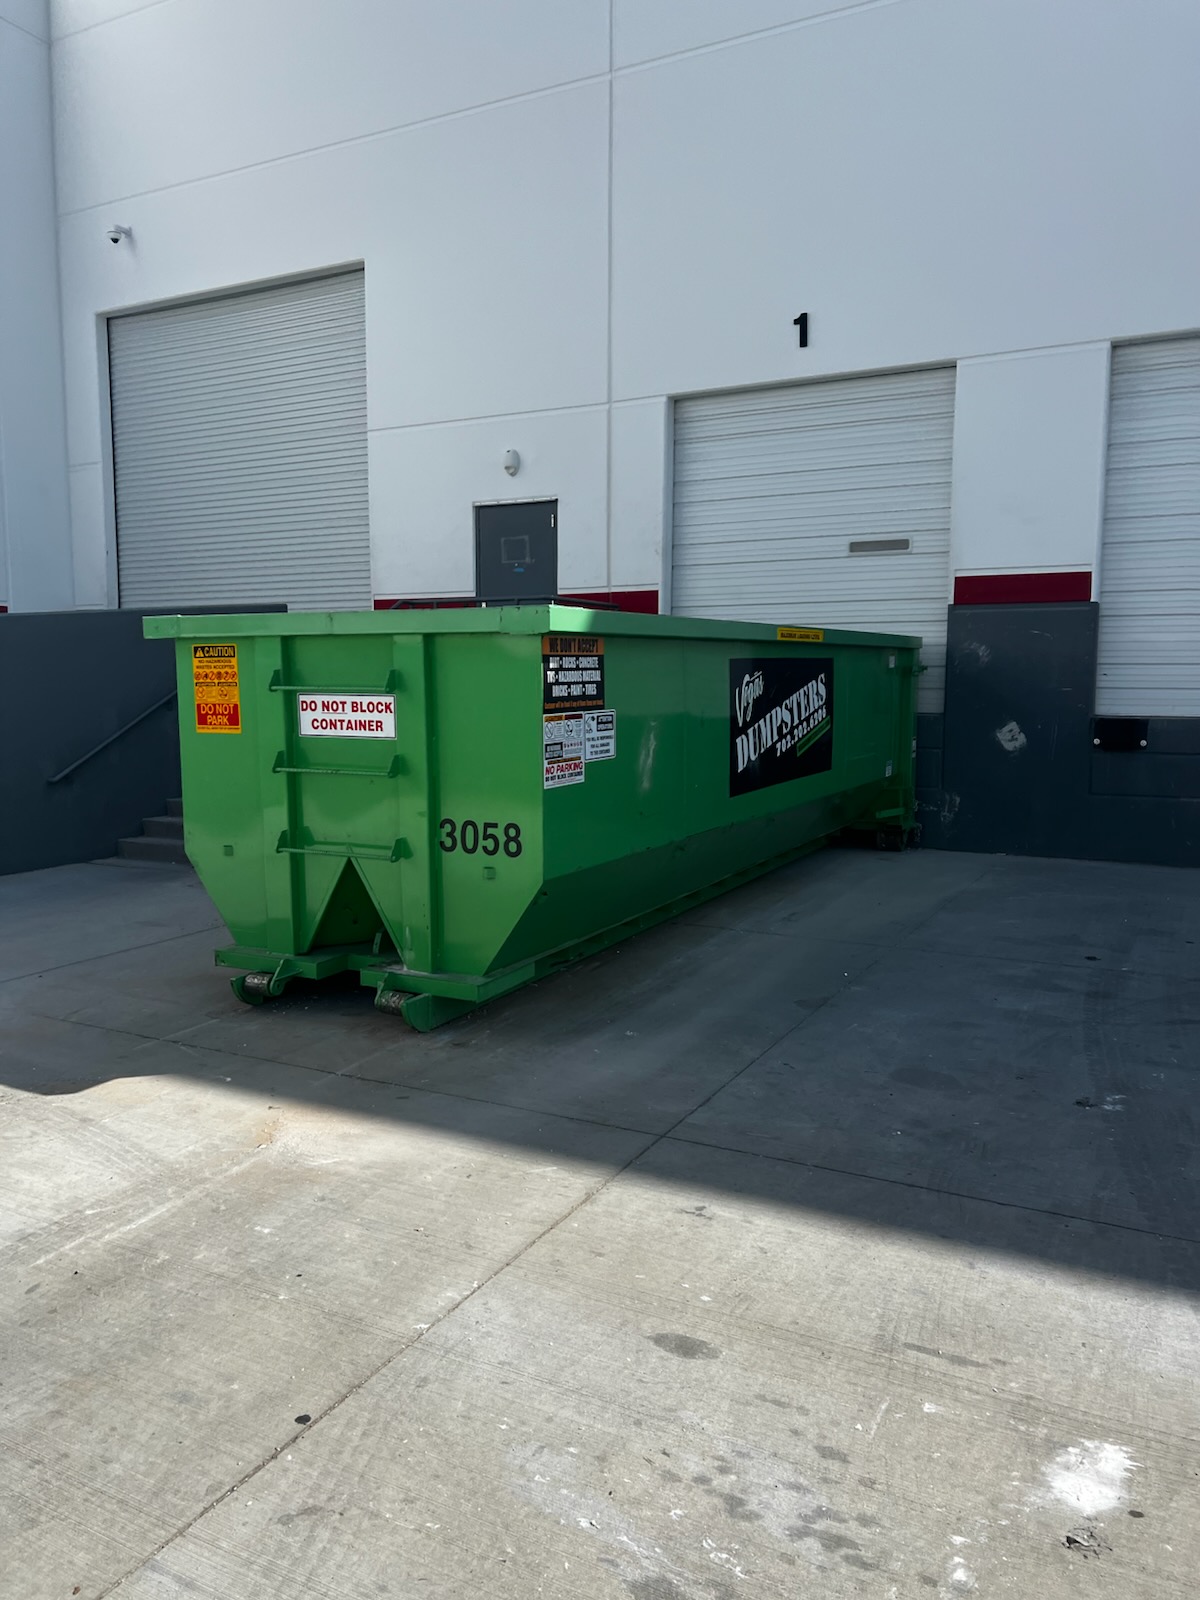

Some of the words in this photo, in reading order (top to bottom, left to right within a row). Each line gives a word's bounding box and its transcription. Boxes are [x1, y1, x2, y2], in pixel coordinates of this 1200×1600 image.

[794, 313, 808, 347] 1
[204, 646, 234, 656] CAUTION
[549, 638, 558, 653] WE
[560, 638, 576, 653] DON'T
[578, 638, 598, 653] ACCEPT
[562, 656, 576, 668] ROCKS
[579, 656, 598, 668] CONCRETE
[559, 670, 582, 682] HAZARDOUS
[583, 670, 601, 682] MATERIAL
[552, 685, 568, 697] BRICKS
[570, 684, 583, 696] PAINT
[585, 684, 597, 695] TIRES
[736, 671, 764, 727] Vegas
[200, 704, 214, 714] DO
[216, 704, 234, 714] NOT
[301, 700, 317, 712] DO
[322, 701, 347, 712] NOT
[351, 701, 393, 713] BLOCK
[207, 715, 229, 725] PARK
[312, 718, 383, 731] CONTAINER
[736, 673, 826, 773] DUMPSTERS
[545, 765, 554, 775] NO
[556, 761, 584, 774] PARKING
[440, 818, 522, 858] 3058
